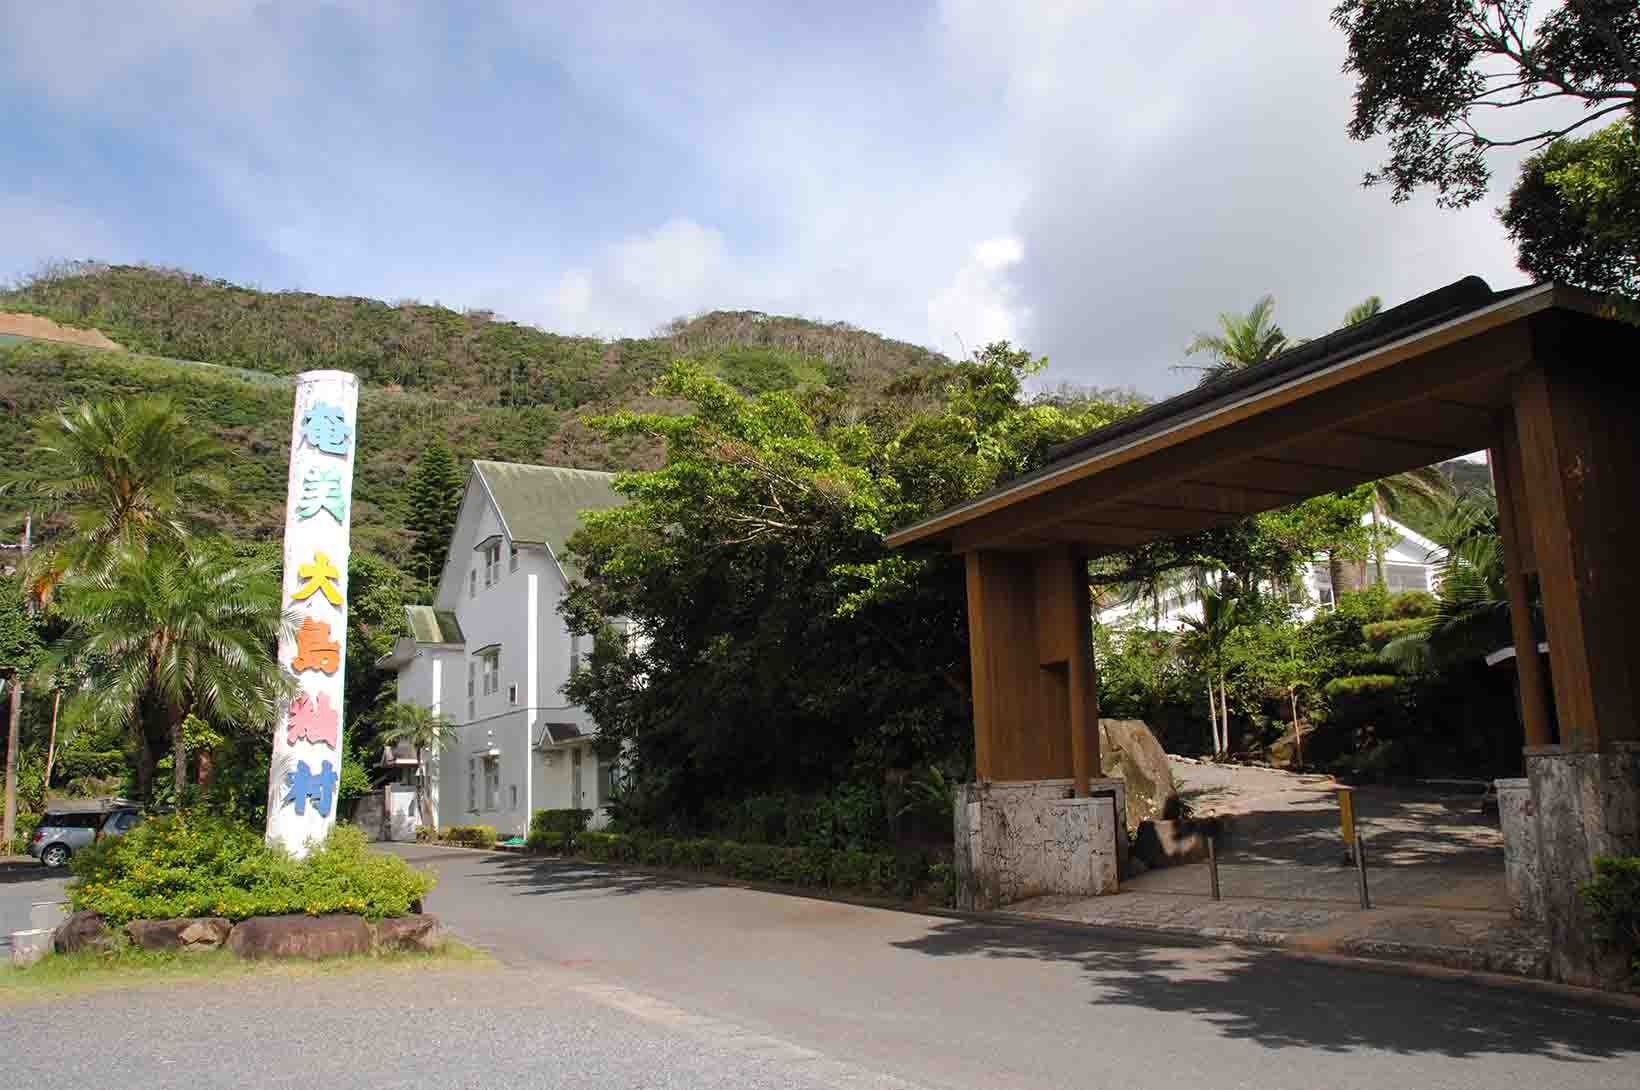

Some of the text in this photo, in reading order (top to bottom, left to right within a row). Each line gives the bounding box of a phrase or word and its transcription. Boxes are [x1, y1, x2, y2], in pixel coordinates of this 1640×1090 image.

[285, 403, 351, 817] 奄美大島紬村
